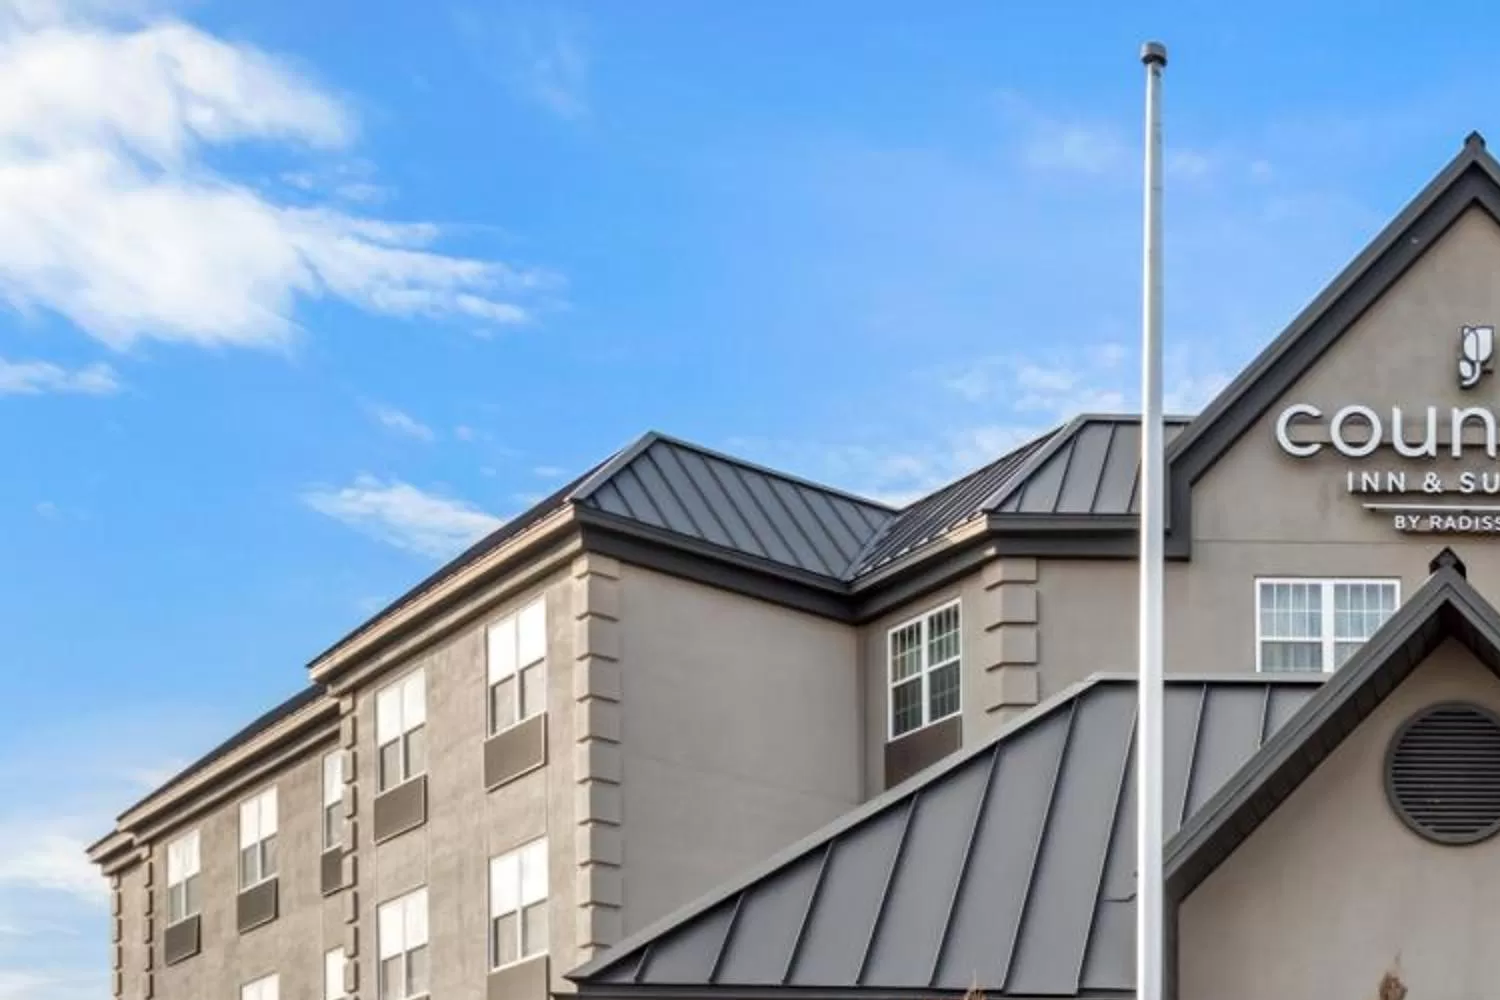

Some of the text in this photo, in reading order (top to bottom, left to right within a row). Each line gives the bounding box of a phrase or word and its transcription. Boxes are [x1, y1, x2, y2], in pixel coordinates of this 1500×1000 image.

[1347, 470, 1407, 493] INN
[1423, 472, 1442, 493] &
[1394, 514, 1420, 529] BY
